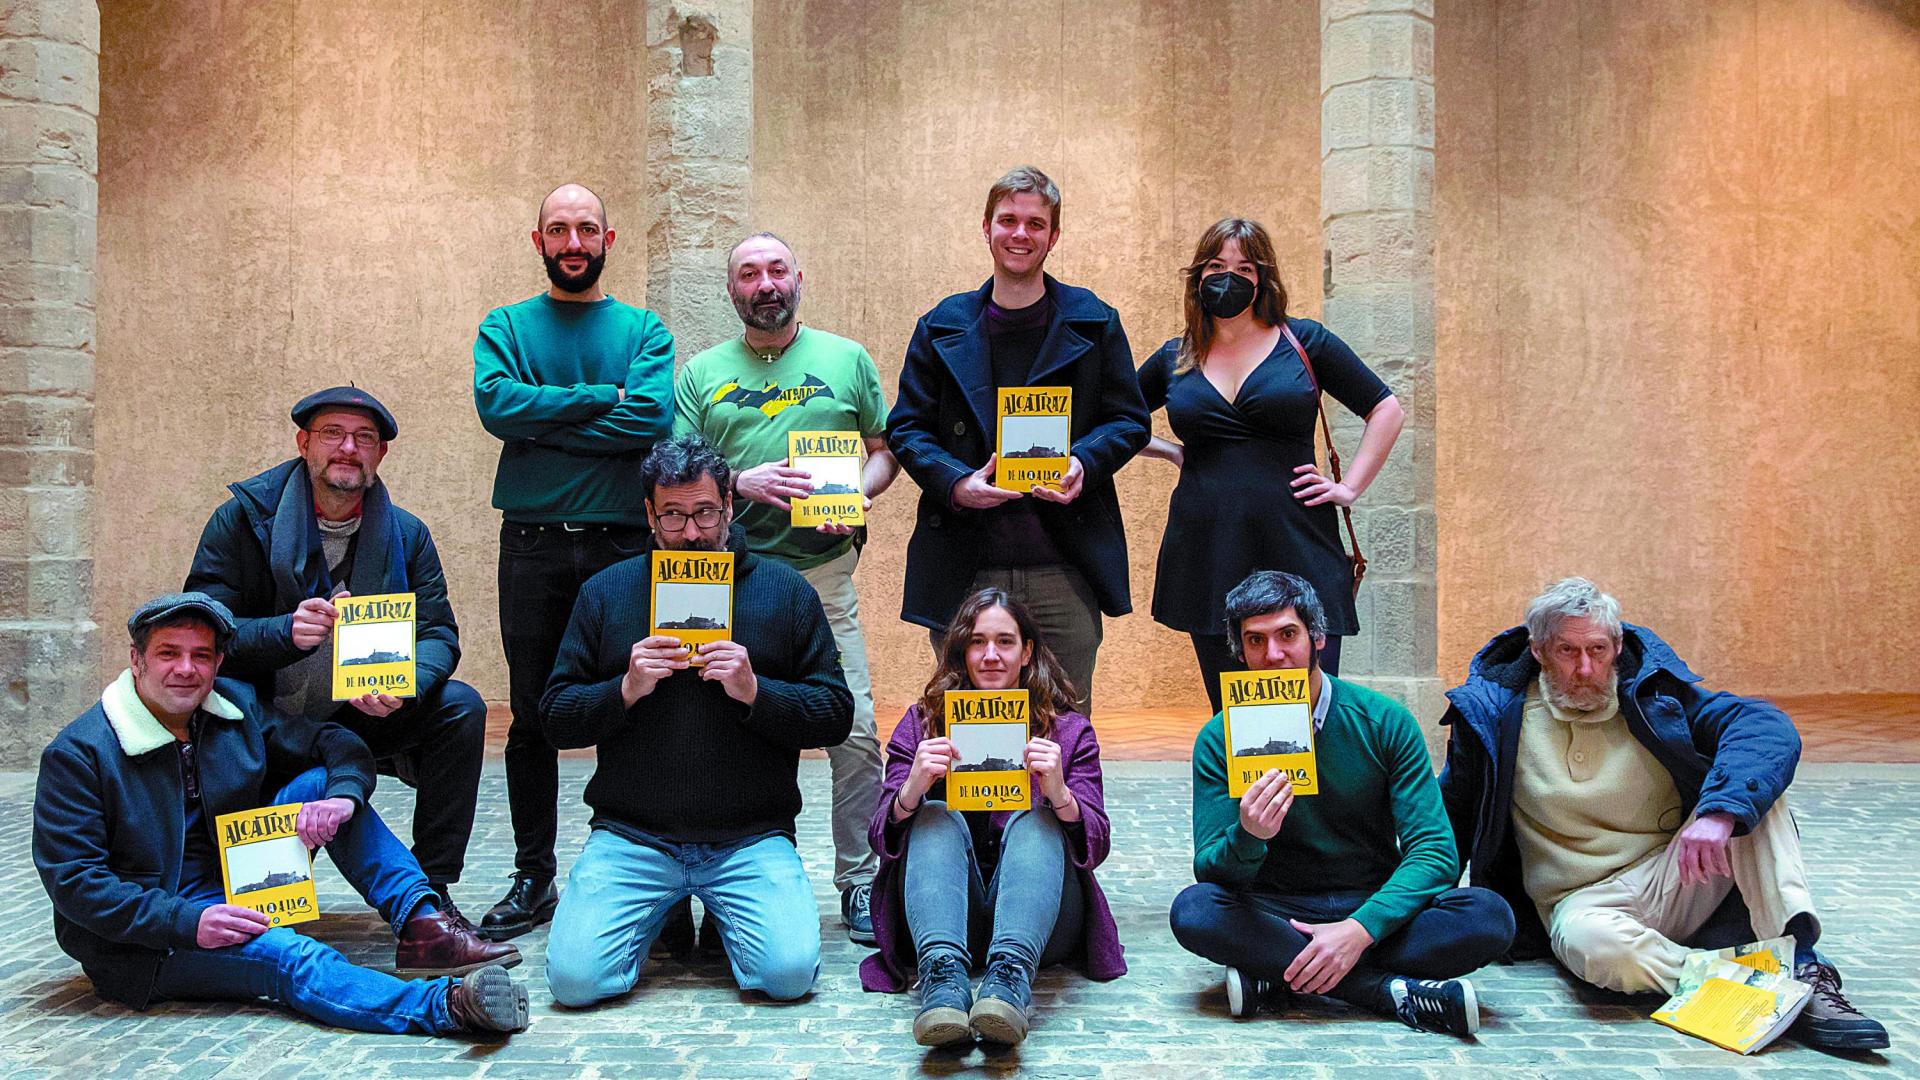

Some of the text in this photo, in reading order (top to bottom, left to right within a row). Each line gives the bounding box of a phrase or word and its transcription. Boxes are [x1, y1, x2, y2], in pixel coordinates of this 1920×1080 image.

[1004, 392, 1069, 415] ALCATRAZ
[795, 436, 858, 455] ALCATRAZ
[658, 558, 731, 581] ALCATRAZ
[341, 599, 412, 624] ALCATRAZ
[1229, 676, 1306, 704] ALCATRAZ
[952, 696, 1025, 722] ALCATRAZ
